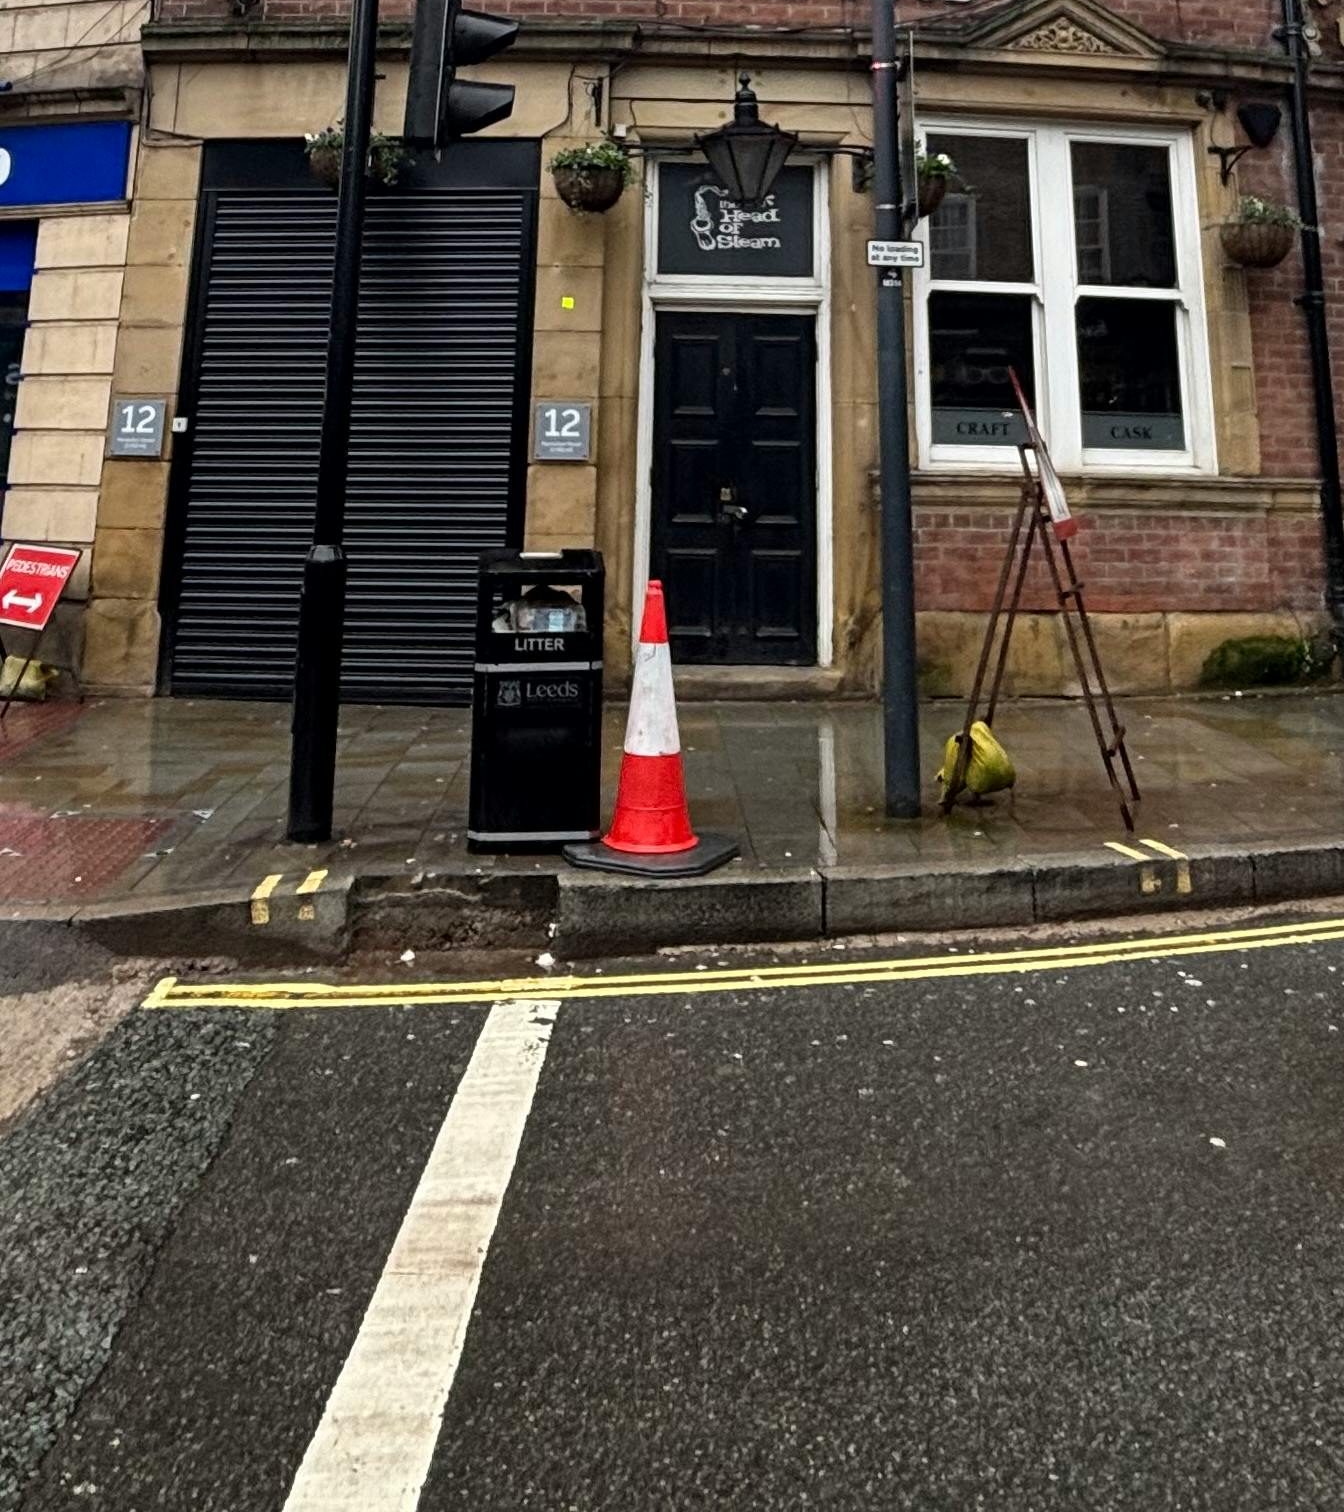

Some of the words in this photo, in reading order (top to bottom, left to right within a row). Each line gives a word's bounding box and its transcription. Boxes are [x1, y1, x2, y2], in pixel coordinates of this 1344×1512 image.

[719, 208, 782, 223] Head
[716, 234, 782, 249] Steam
[871, 244, 885, 252] No
[886, 244, 919, 255] loading
[882, 255, 898, 263] any
[121, 405, 156, 434] 12
[544, 408, 581, 437] 12
[956, 420, 1010, 437] CRAFT
[1109, 425, 1153, 441] CASK
[6, 558, 72, 579] PEDESTRIANS
[514, 638, 565, 652] LITTER
[525, 680, 579, 698] Leeds
